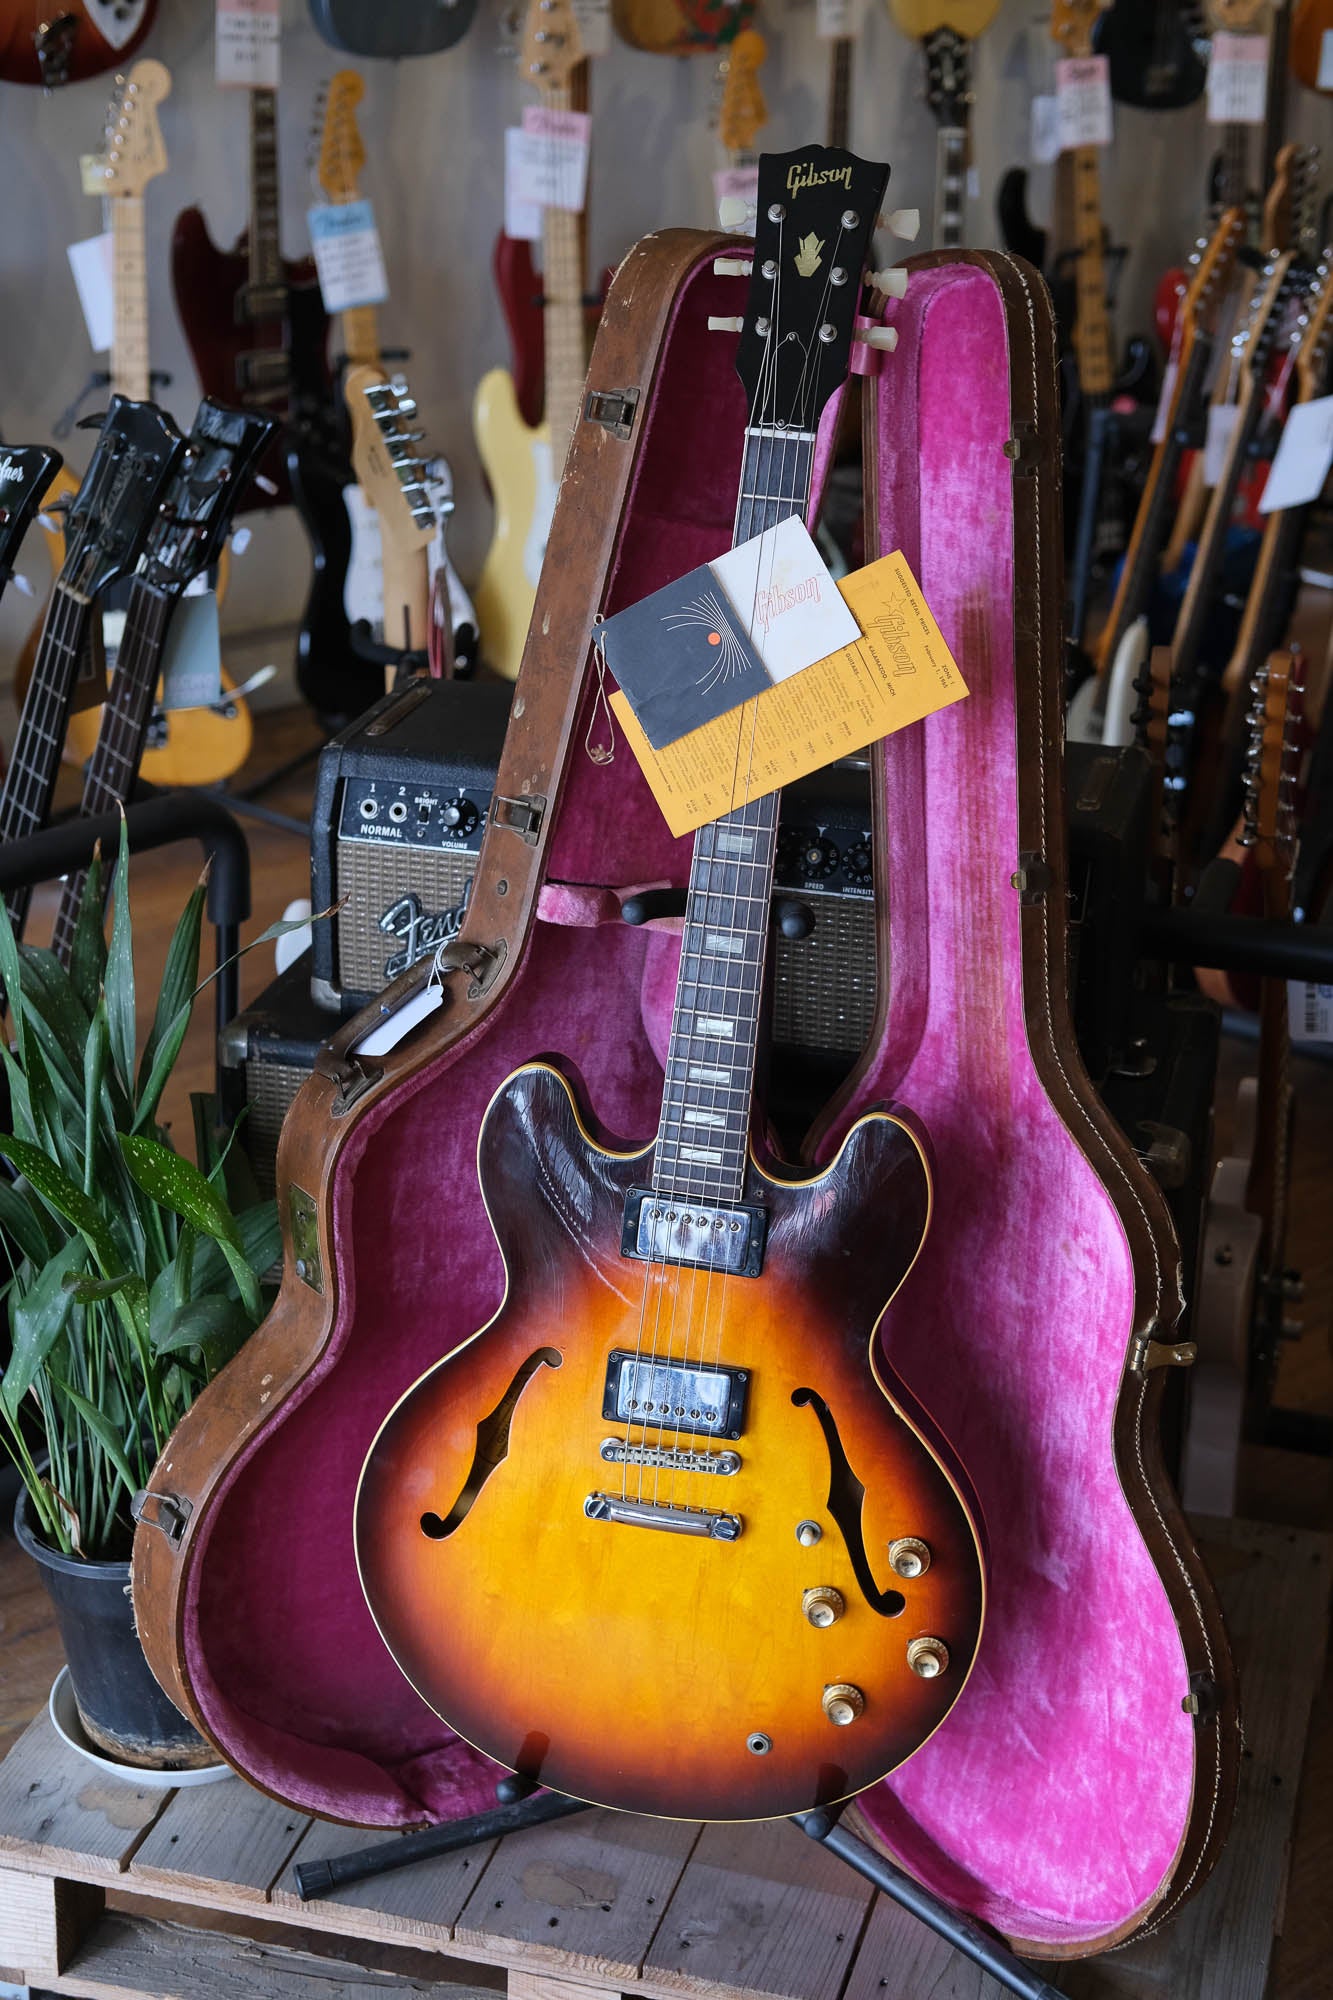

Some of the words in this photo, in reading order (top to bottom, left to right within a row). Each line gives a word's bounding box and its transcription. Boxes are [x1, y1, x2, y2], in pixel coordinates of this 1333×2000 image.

[786, 162, 853, 199] Gibson
[0, 456, 25, 483] fner
[755, 577, 822, 634] Gibson
[895, 567, 912, 597] SUGGESTED
[909, 598, 921, 617] RETAIL
[918, 617, 930, 636] PRICES
[866, 613, 918, 678] Gibson
[924, 644, 937, 668] February
[941, 664, 952, 680] ZONE
[370, 783, 376, 793] 1
[398, 786, 406, 796] 2
[414, 796, 439, 806] BRIGHT
[360, 824, 403, 838] NORMAL
[441, 840, 468, 849] VOLUME
[804, 881, 825, 890] SPEED
[379, 879, 473, 978] Fend
